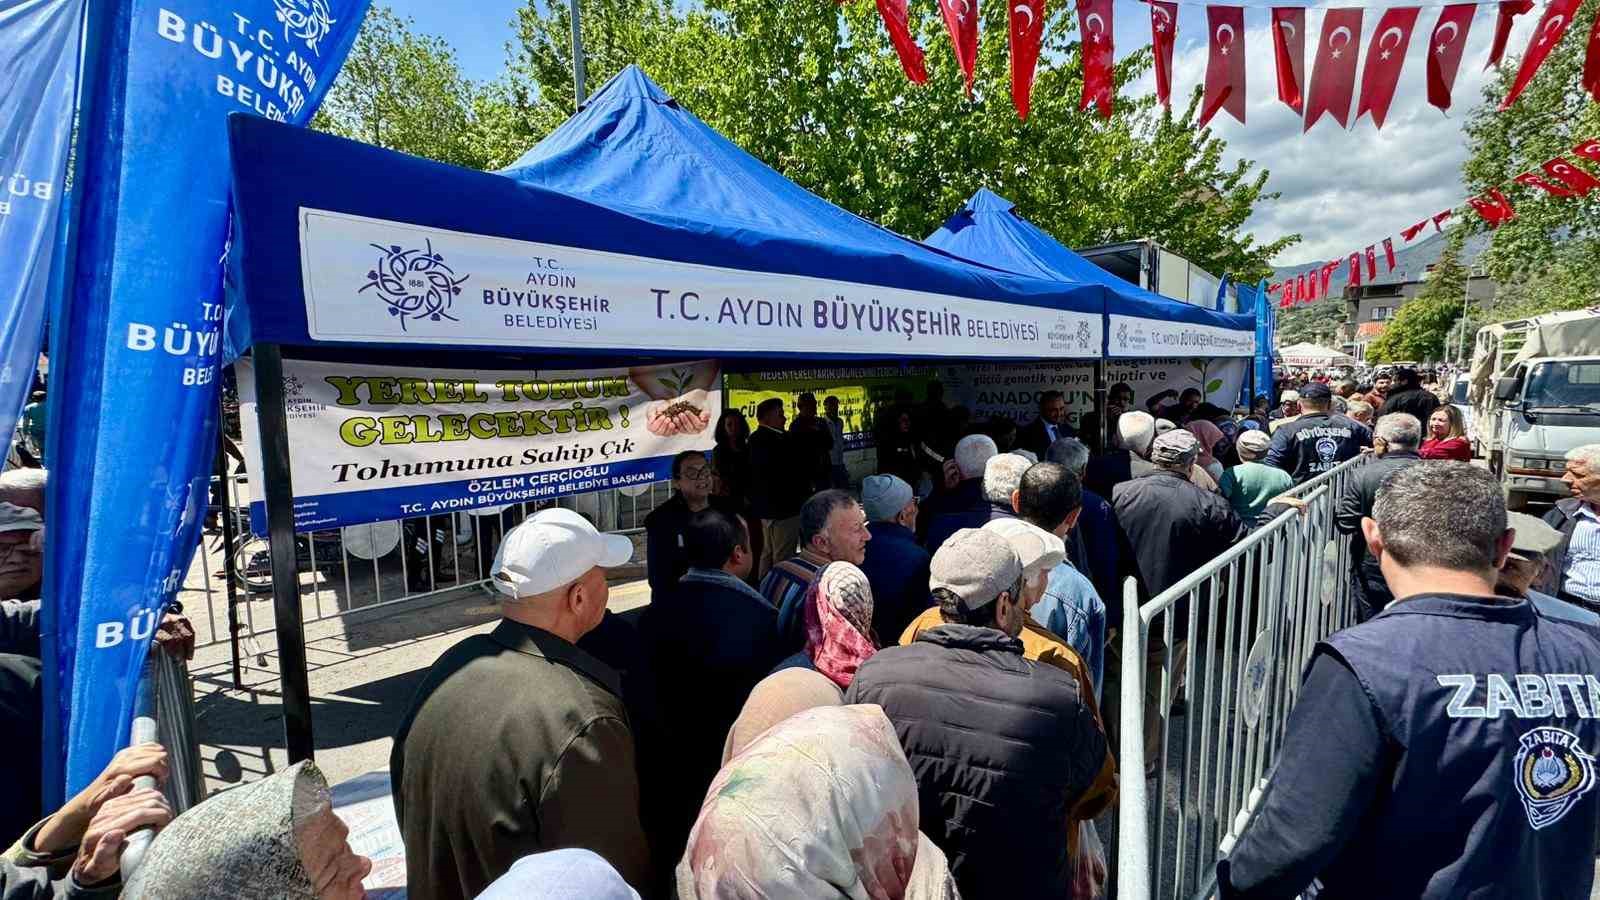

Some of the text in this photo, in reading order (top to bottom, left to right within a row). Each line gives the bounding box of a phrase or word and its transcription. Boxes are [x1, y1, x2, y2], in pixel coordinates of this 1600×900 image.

[232, 11, 280, 57] T.C.
[533, 256, 565, 271] T.C.
[526, 272, 577, 289] AYDIN
[482, 289, 610, 315] BÜYÜKŞEHİR
[650, 288, 709, 322] T.C.
[717, 297, 802, 328] AYDIN
[813, 296, 962, 340] BÜYÜKŞEHİR
[967, 319, 1039, 342] BELEDİYESİ
[503, 313, 598, 331] BELEDİYESİ
[325, 374, 632, 406] YEREL TOHUM
[1051, 372, 1090, 385] yapıya
[1107, 369, 1146, 384] hiptir
[1149, 371, 1167, 381] ve
[339, 401, 612, 447] GELECEKTİR
[331, 436, 636, 483] Tohumuna Sahip Çık
[400, 471, 655, 514] T.C. AYDIN BÜYÜKŞEHİR BELEDİYE BAŞKANI
[468, 463, 610, 493] ÖZLEM ÇERÇİOĞLU
[1526, 730, 1569, 747] ZABITA
